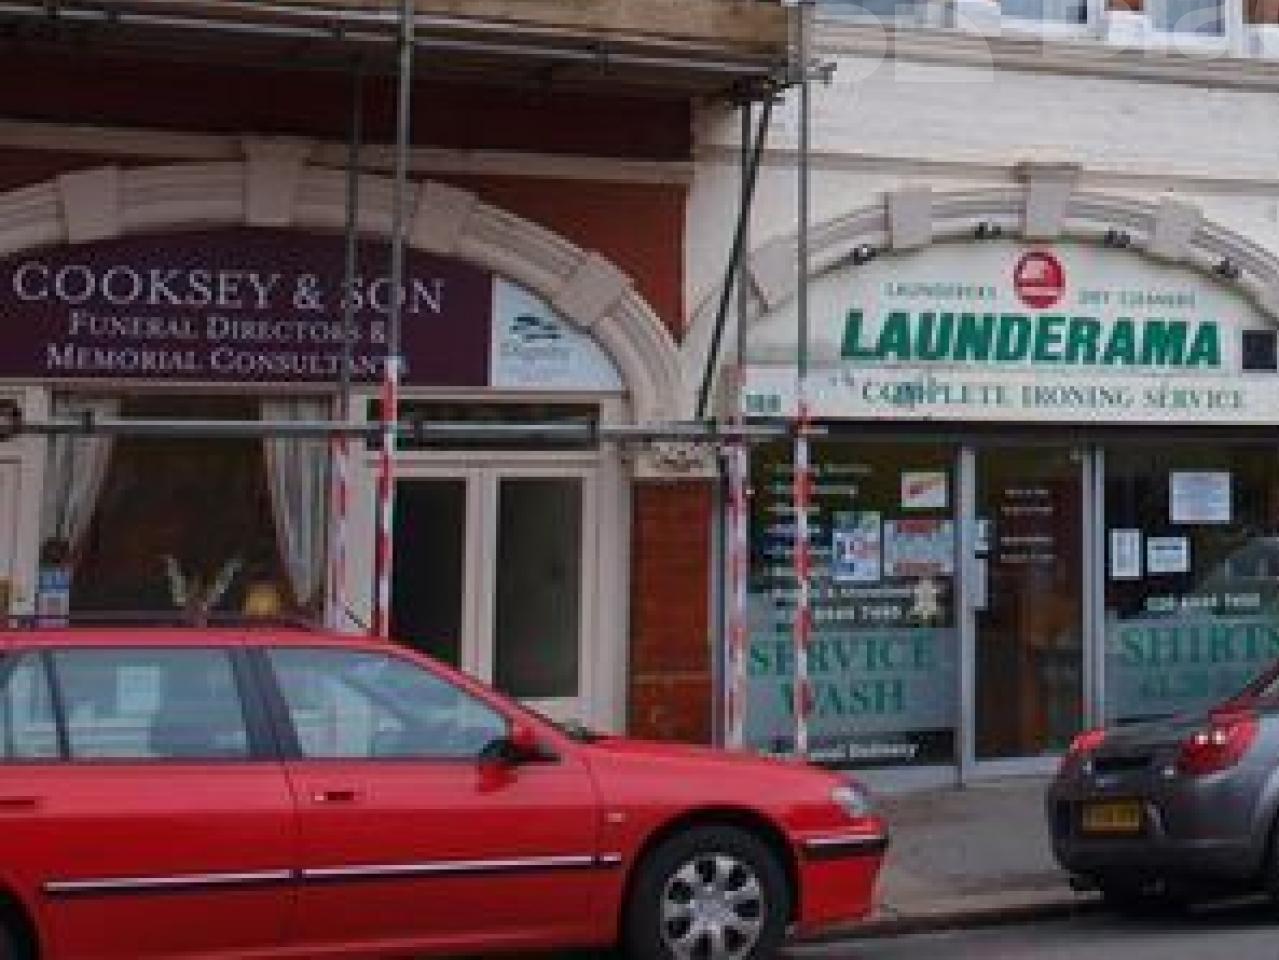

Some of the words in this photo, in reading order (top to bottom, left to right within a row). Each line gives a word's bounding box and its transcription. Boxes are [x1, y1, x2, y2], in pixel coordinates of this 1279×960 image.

[12, 261, 281, 309] COOKSEY
[293, 273, 324, 309] &
[341, 277, 442, 315] SON
[69, 309, 202, 337] FUNERAL
[841, 310, 1222, 366] LAUNDERAMA
[48, 342, 202, 370] MEMORIAL
[862, 380, 1008, 409] COMPLETE
[1022, 384, 1134, 409] IRONING
[1142, 384, 1246, 410] SERVICE
[749, 632, 934, 676] SERVICE
